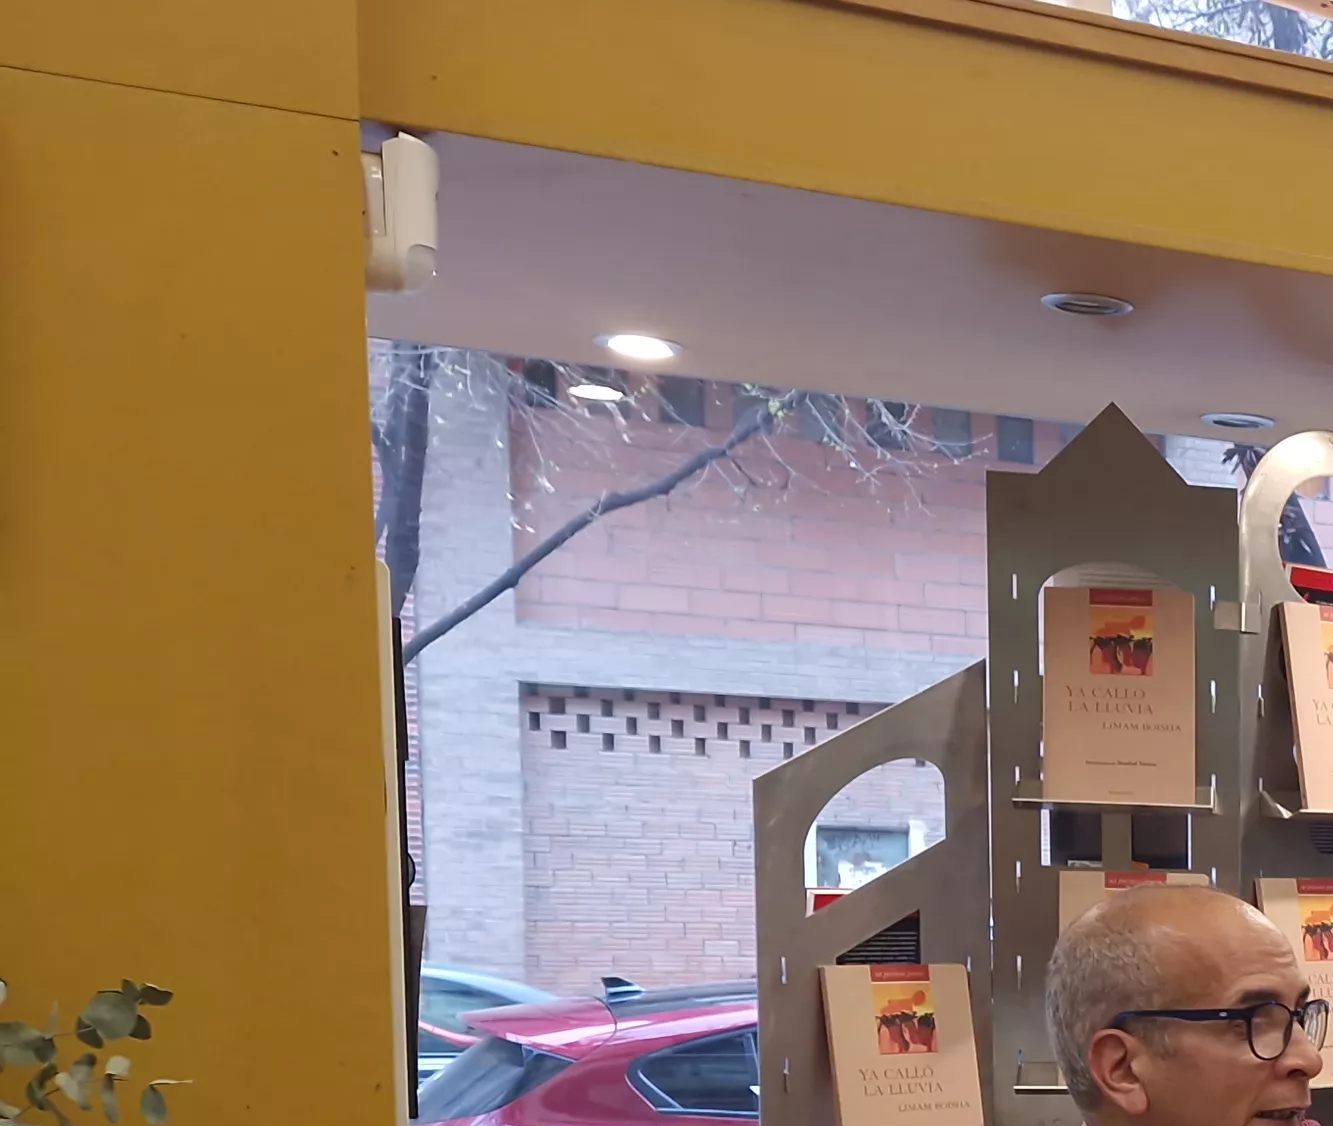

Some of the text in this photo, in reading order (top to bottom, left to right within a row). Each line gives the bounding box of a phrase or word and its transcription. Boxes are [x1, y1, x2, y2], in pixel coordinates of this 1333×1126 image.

[1066, 686, 1086, 698] YA
[1068, 701, 1154, 715] LA LLUVIA
[859, 1068, 878, 1081] YA
[864, 1082, 943, 1097] LA LLUVIA
